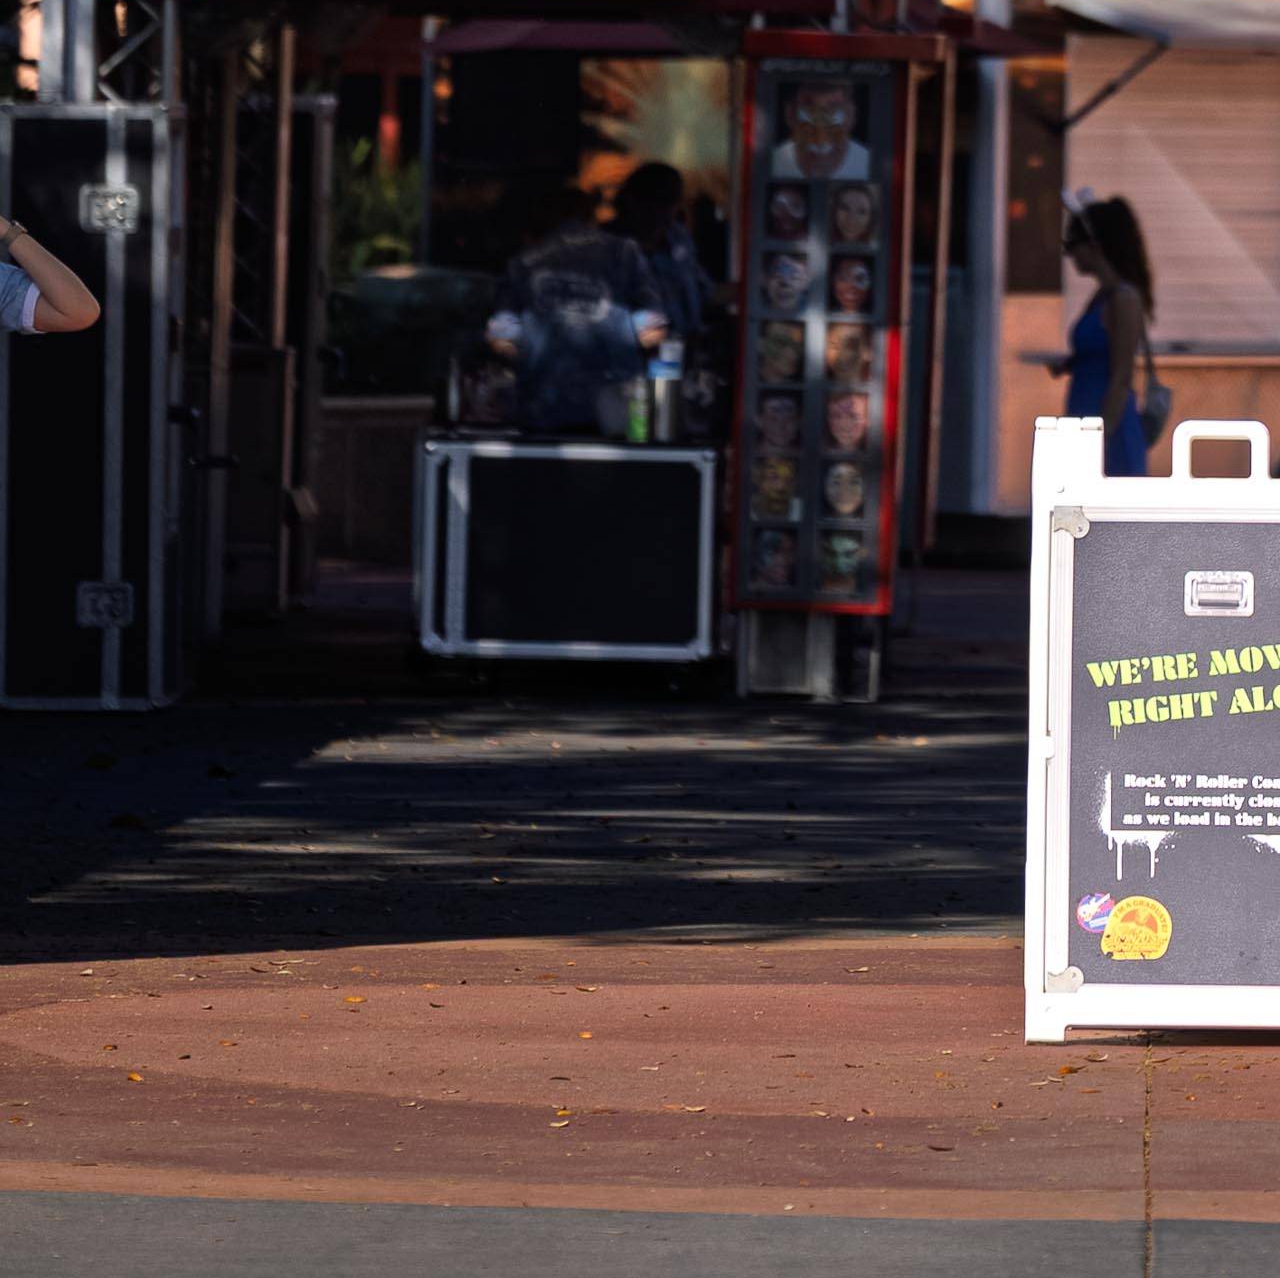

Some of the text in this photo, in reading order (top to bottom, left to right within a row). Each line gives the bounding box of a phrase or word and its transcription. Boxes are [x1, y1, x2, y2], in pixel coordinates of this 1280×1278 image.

[1086, 652, 1199, 688] WE'RE
[1107, 690, 1218, 728] RIGHT
[1124, 773, 1167, 789] Rock
[1170, 774, 1192, 789] 'N'
[1195, 774, 1248, 790] Roller
[1144, 792, 1160, 807] is
[1163, 793, 1245, 810] currently
[1122, 813, 1143, 825] as
[1146, 814, 1170, 826] we
[1173, 811, 1210, 826] load
[1214, 812, 1231, 826] in
[1234, 812, 1263, 827] the
